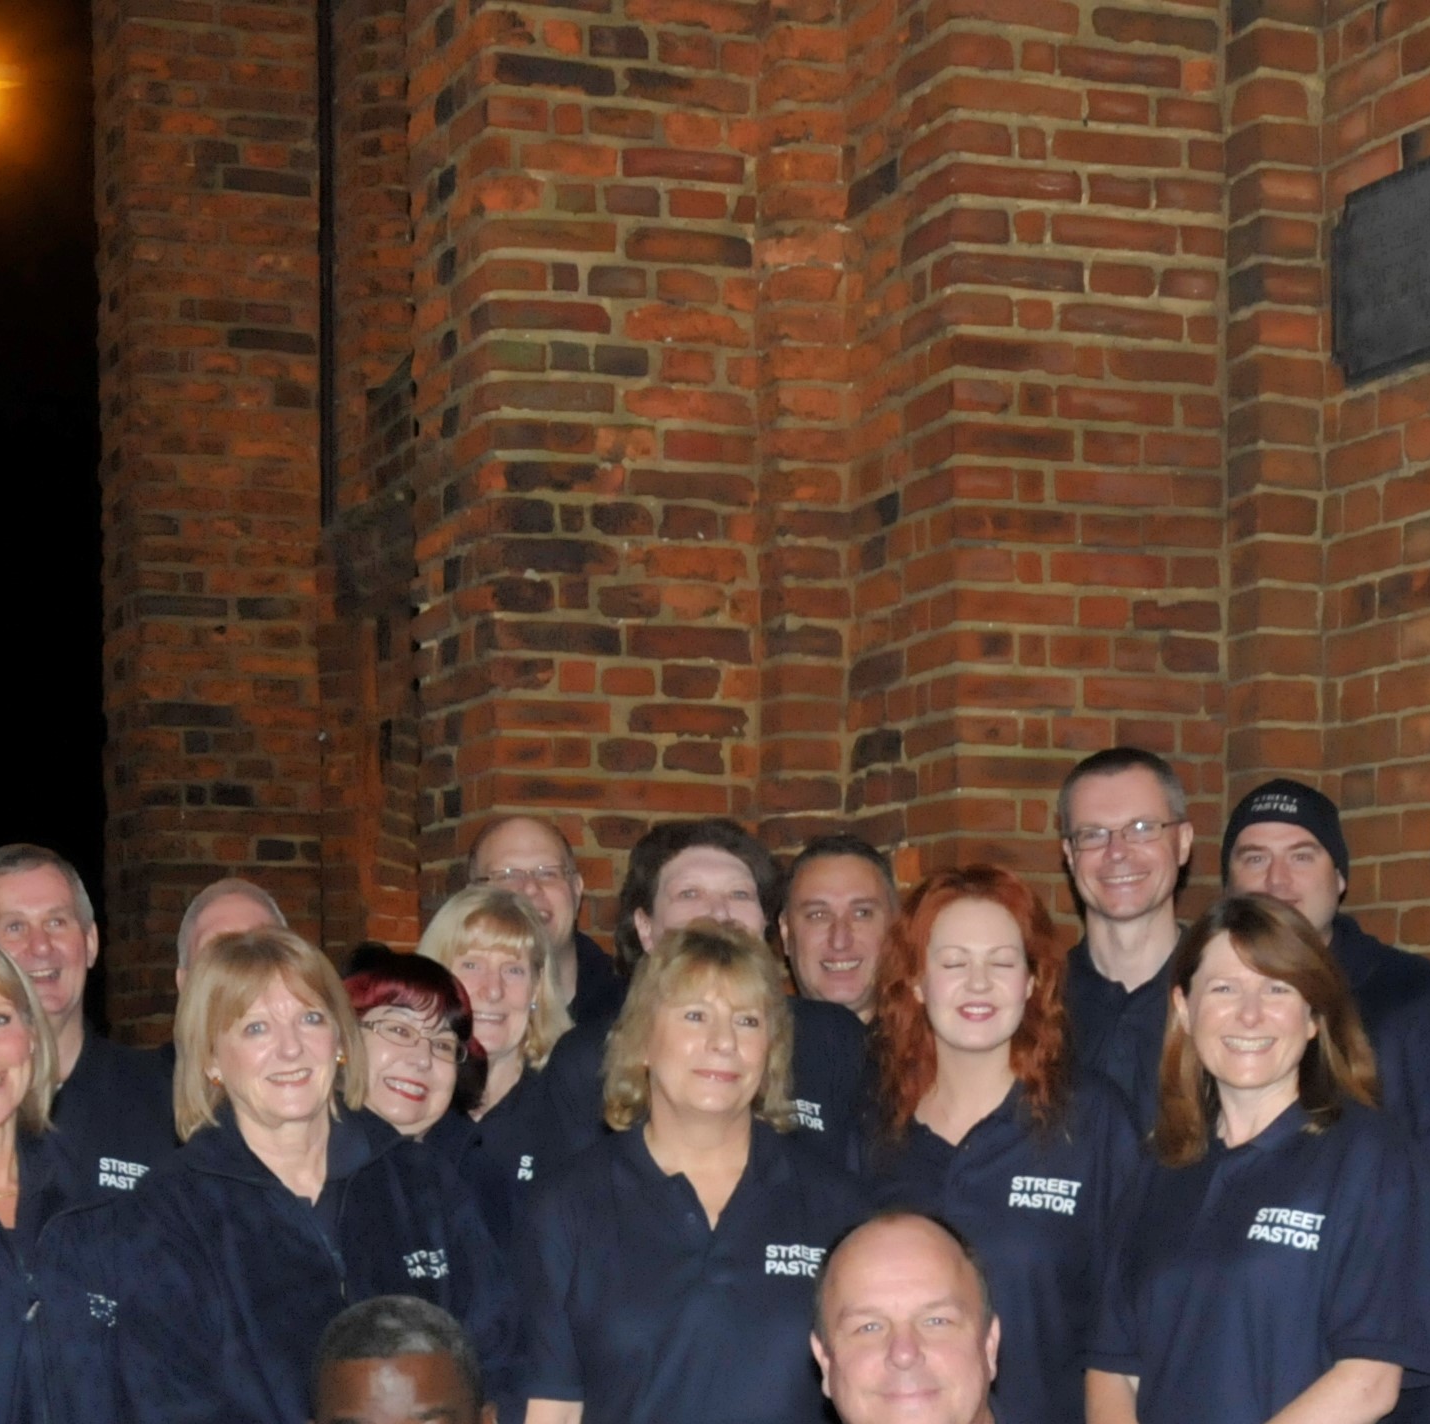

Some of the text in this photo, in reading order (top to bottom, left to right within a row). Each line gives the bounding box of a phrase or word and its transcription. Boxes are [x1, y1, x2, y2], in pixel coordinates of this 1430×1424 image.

[99, 1172, 136, 1190] PAST
[1011, 1176, 1082, 1197] STREET
[1008, 1192, 1077, 1215] PASTOR
[1255, 1207, 1326, 1231] STREET
[1247, 1224, 1320, 1251] PASTOR
[765, 1244, 826, 1263] STREE
[765, 1260, 819, 1278] PASTO
